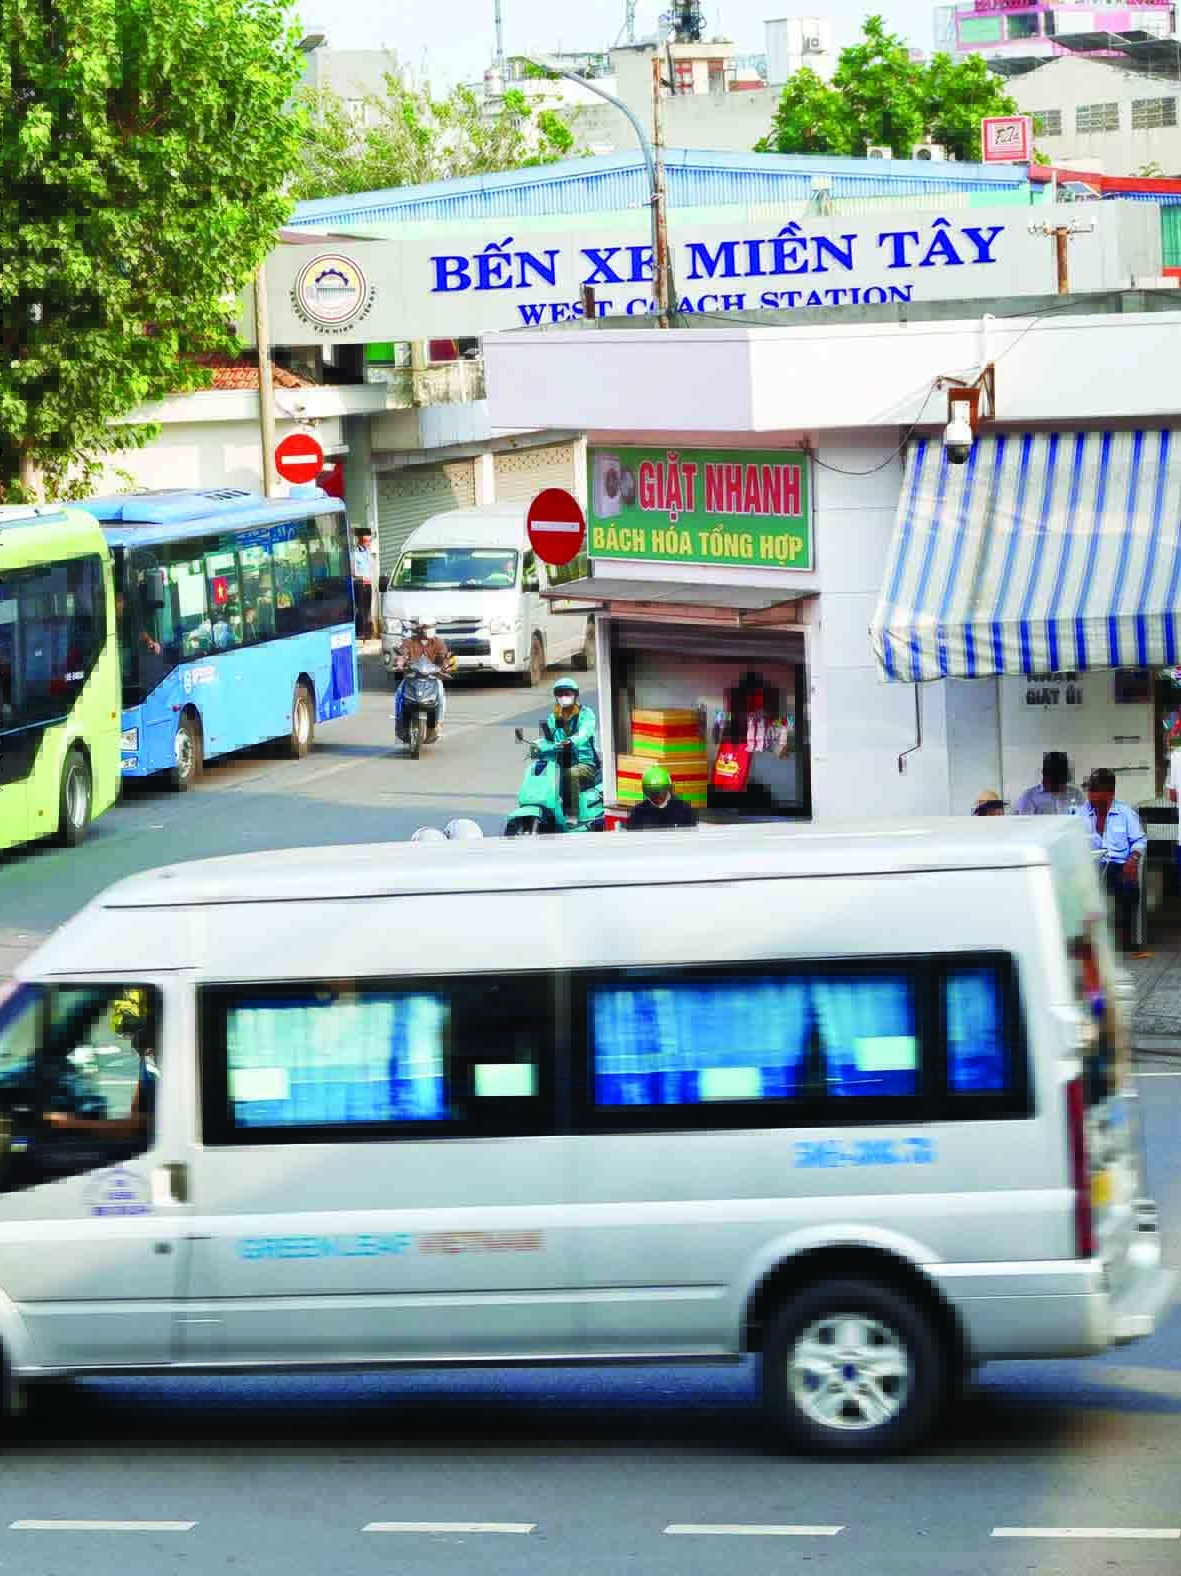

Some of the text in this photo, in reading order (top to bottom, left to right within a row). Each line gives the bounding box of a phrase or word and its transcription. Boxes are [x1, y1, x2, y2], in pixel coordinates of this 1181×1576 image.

[430, 237, 560, 292] BẾN
[685, 221, 859, 280] MIỀN
[879, 217, 1006, 269] TÂY
[760, 285, 914, 308] STATION
[638, 451, 803, 523] GIẶT NHANH
[593, 523, 804, 566] BÁCH HÓA TỔNG HỢP
